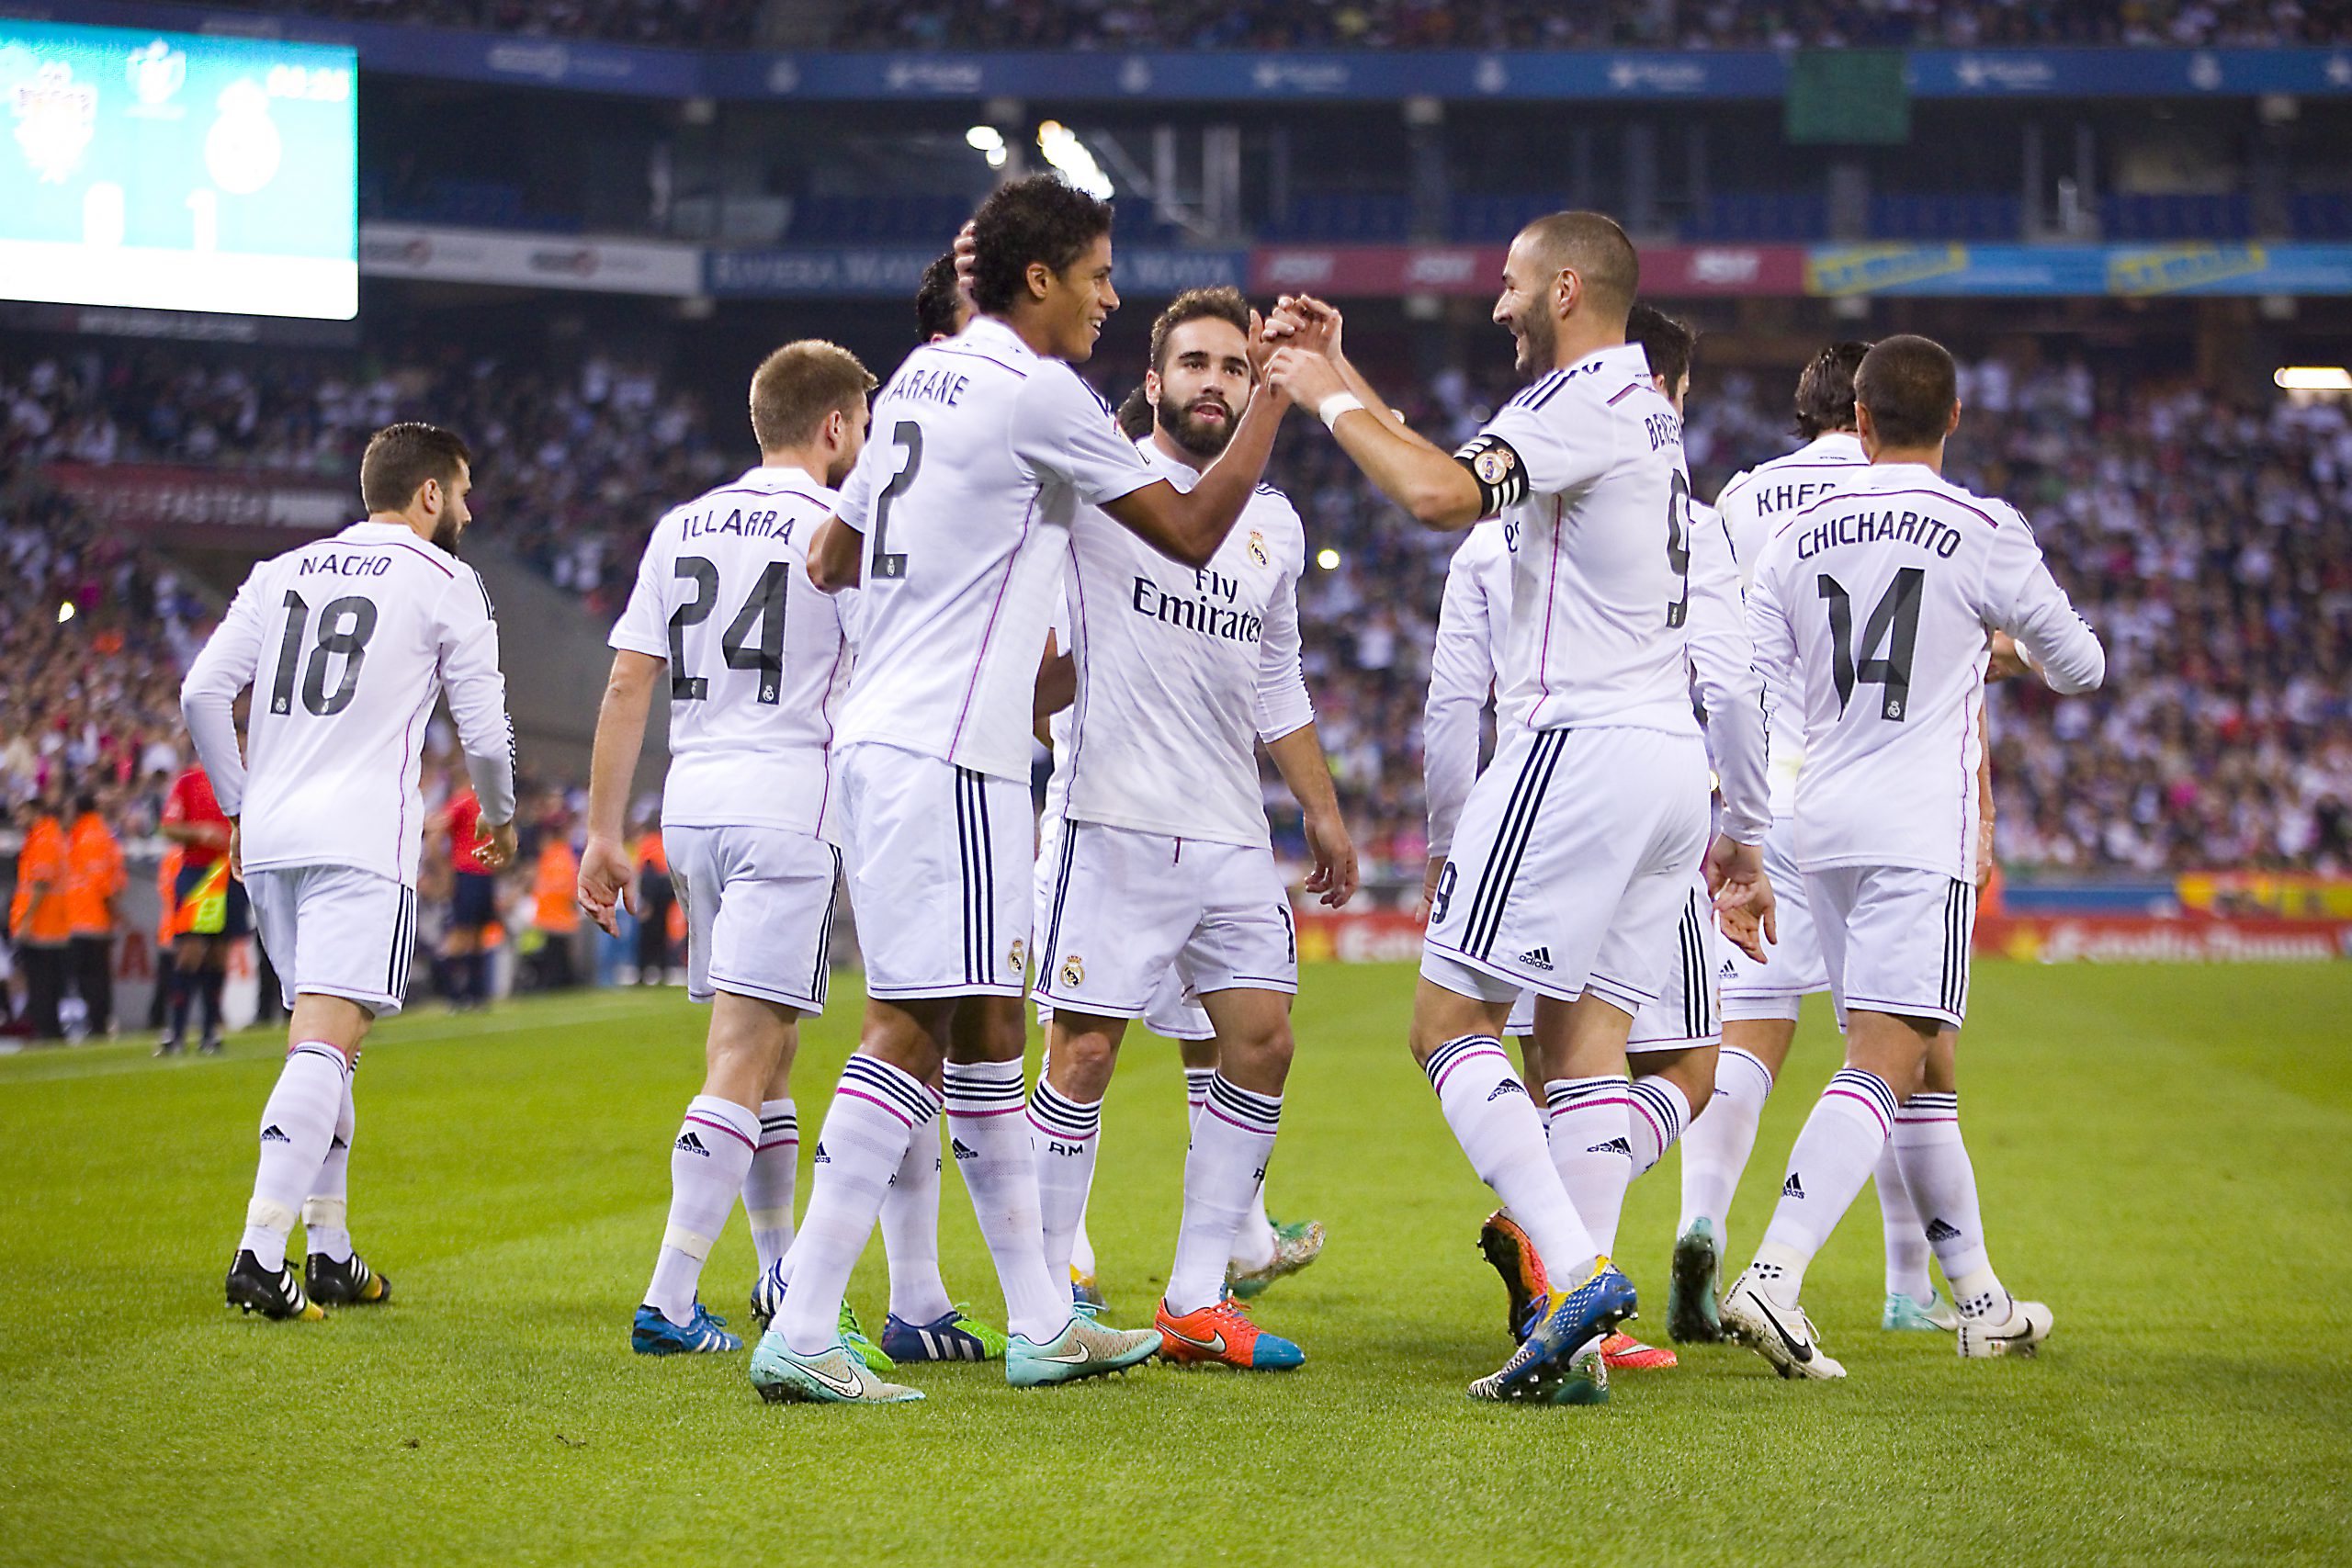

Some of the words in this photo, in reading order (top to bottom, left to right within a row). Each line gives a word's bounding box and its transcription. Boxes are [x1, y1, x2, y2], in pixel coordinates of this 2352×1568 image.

[1645, 413, 1682, 452] BENZE
[871, 421, 923, 580] 2
[682, 508, 796, 546] ILLARRA
[1798, 511, 1962, 560] CHICHARITO
[300, 554, 391, 576] NACHO
[1195, 568, 1238, 604] Fly
[270, 589, 378, 716] 18
[668, 556, 790, 705] 24
[1816, 567, 1926, 723] 14
[1431, 861, 1458, 925] 9
[1519, 953, 1555, 972] adidas
